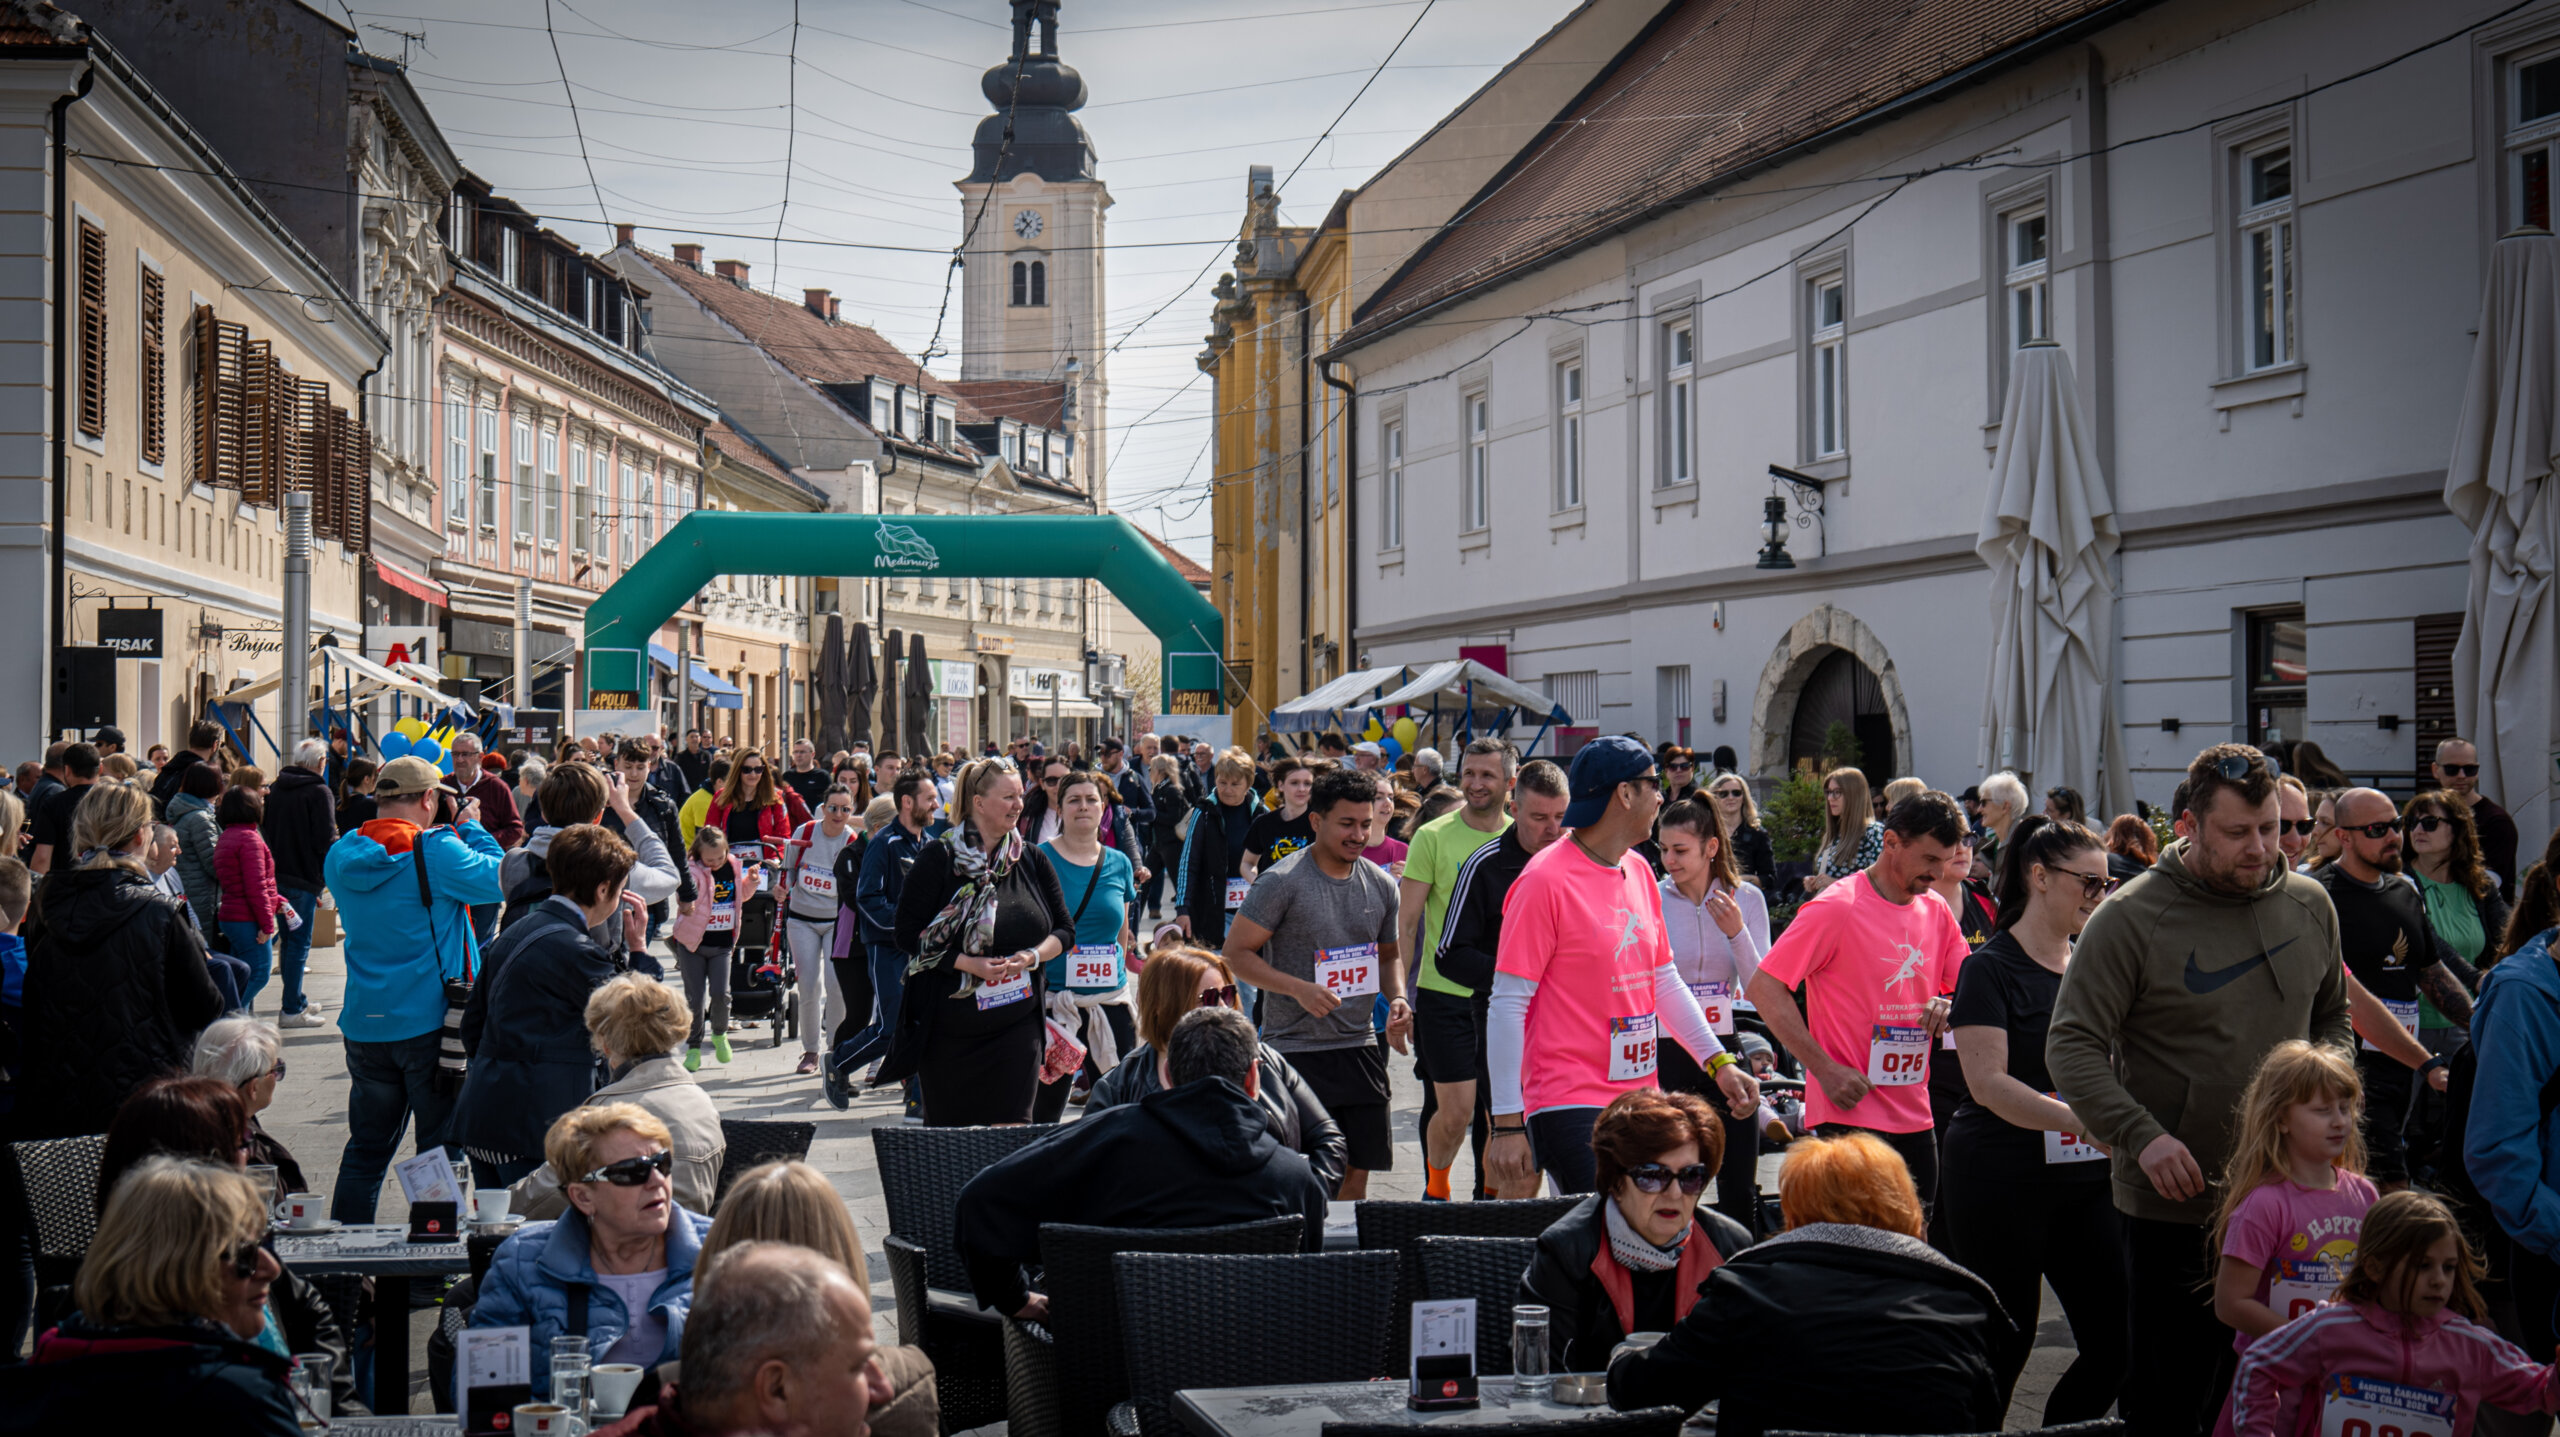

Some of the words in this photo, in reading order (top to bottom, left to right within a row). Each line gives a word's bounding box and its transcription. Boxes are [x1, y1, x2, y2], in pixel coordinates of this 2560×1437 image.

[105, 638, 154, 651] TISAK
[947, 678, 969, 695] LOGOS
[600, 693, 629, 706] POLU
[1182, 692, 1210, 705] POLU
[1171, 704, 1219, 715] MARATON
[804, 875, 831, 890] 068
[1228, 890, 1249, 901] 21
[709, 914, 731, 925] 244
[1076, 963, 1112, 977] 248
[1327, 966, 1368, 989] 247
[1886, 1003, 1909, 1011] UTRKA
[1880, 1013, 1899, 1021] MALA
[1883, 1053, 1924, 1072] 076
[2299, 1262, 2327, 1273] ŠARENIM
[2304, 1273, 2315, 1281] DO
[2358, 1380, 2391, 1395] ŠARENIM
[2394, 1386, 2439, 1405] ČARAPAMA
[2364, 1392, 2377, 1402] DO
[2379, 1394, 2403, 1407] CILJA
